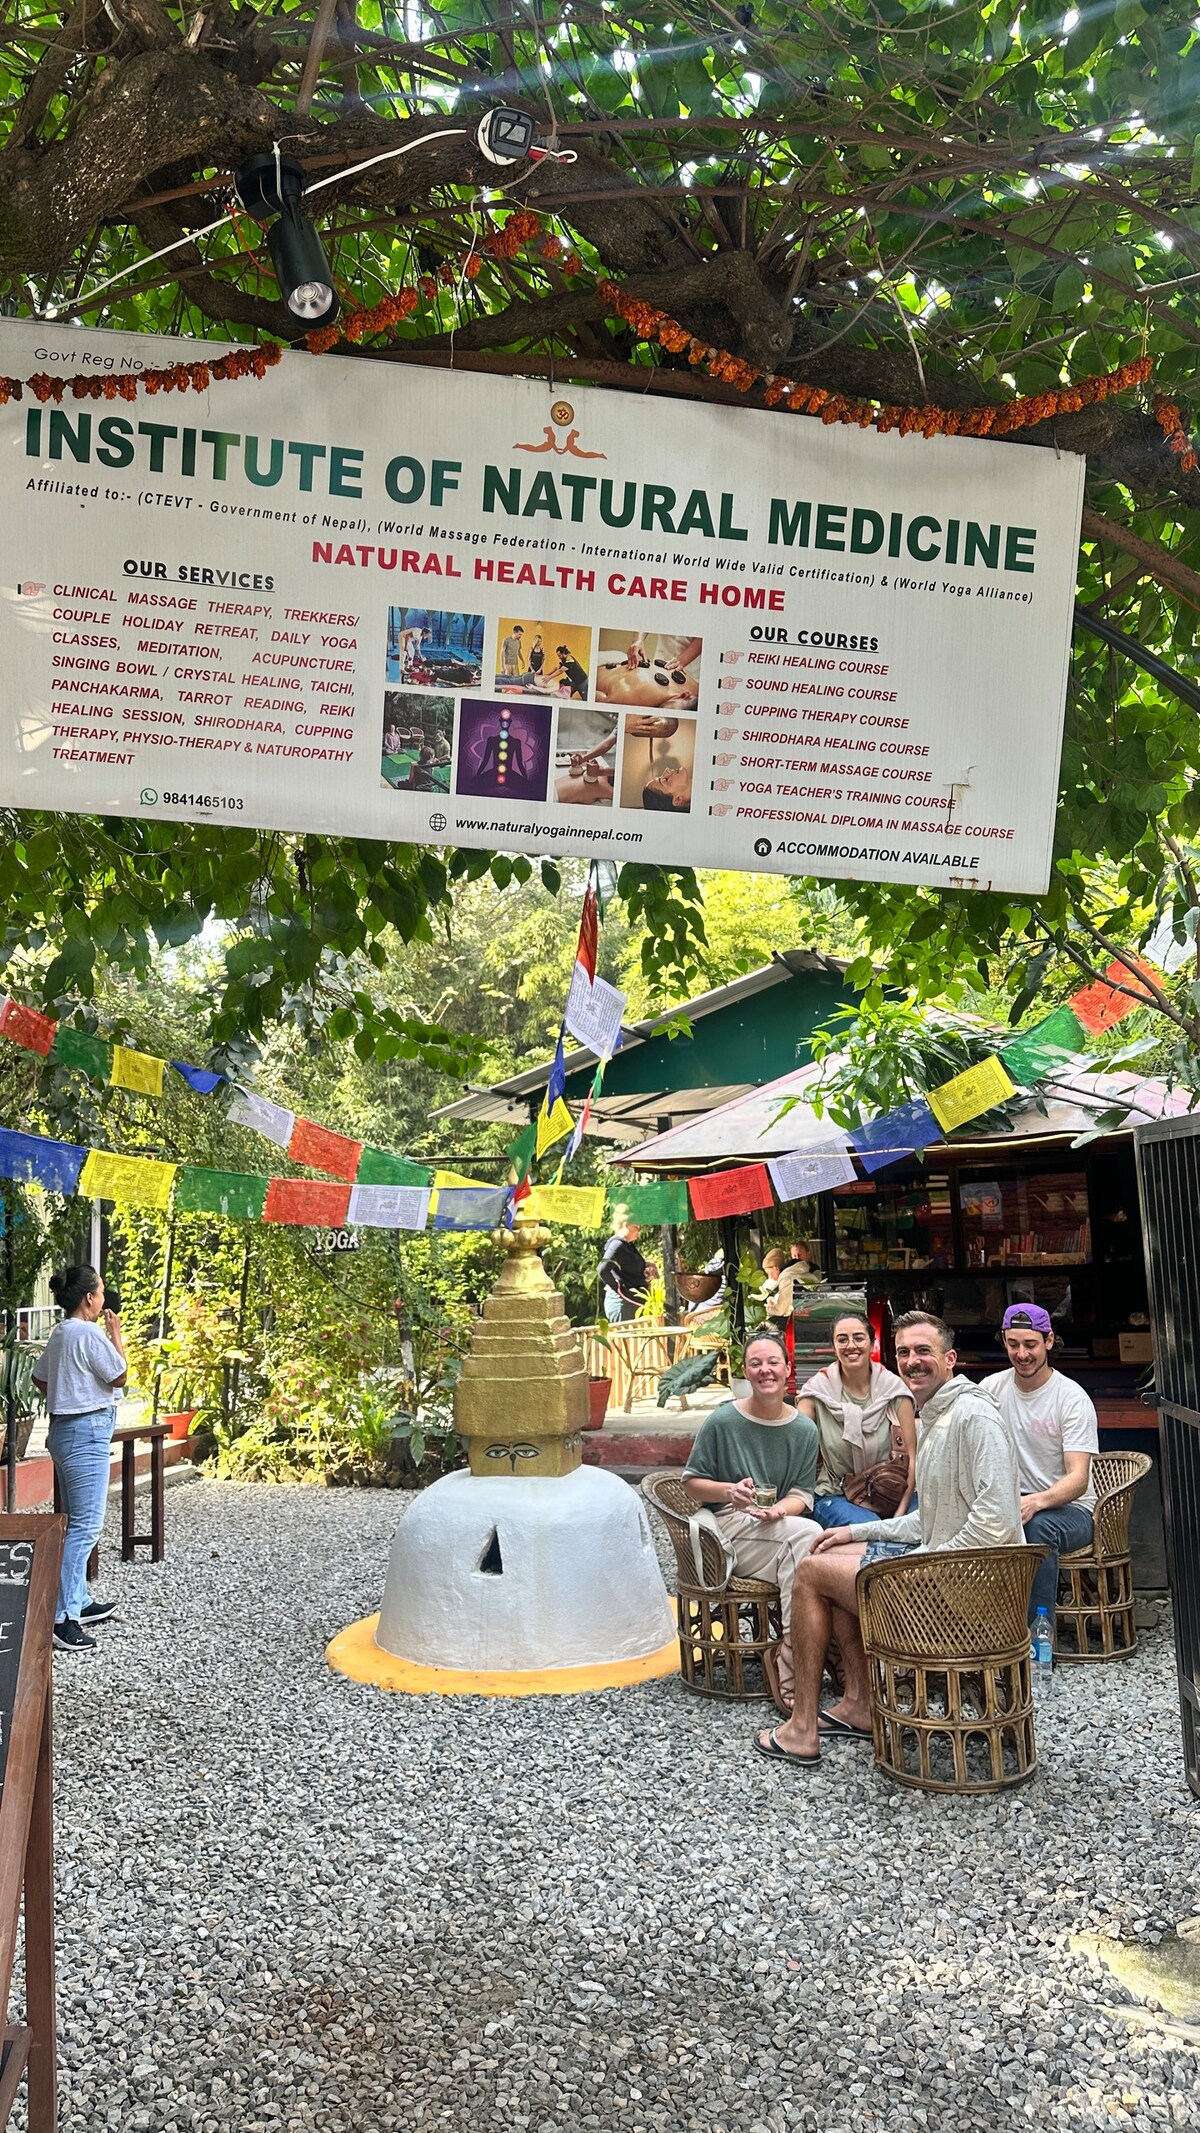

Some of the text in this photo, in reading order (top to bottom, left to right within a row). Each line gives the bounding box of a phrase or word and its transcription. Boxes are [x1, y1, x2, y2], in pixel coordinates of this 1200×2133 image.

[34, 347, 77, 363] Govt
[81, 352, 115, 370] Reg
[25, 407, 1037, 574] INSTITUTE OF NATURAL MEDICINE
[25, 478, 99, 498] Affiliated
[105, 488, 131, 501] to:-
[138, 491, 193, 509] (CTEVT
[210, 500, 297, 523] Government
[302, 513, 318, 525] of
[321, 515, 371, 533] Nepal),
[377, 520, 424, 536] (World
[428, 525, 488, 545] Massage
[492, 533, 566, 552] Federation
[581, 543, 668, 564] International
[672, 553, 711, 568] World
[715, 558, 746, 572] Wide
[752, 561, 785, 576] Valid
[789, 565, 875, 588] Certification)
[880, 575, 888, 587] &
[893, 577, 937, 592] (World
[942, 581, 972, 597] Yoga
[975, 586, 1033, 605] Alliance)
[123, 559, 274, 590] OUR SERVICES
[312, 541, 786, 612] NATURAL HEALTH CARE HOME
[53, 584, 361, 627] CLINICAL MASSAGE THERAPY, TREKKERS/
[52, 608, 357, 650] COUPLE HOLIDAY RETREAT, DAILY YOGA
[750, 625, 879, 651] OUR COURSES
[52, 631, 356, 674] CLASSES, MEDITATION, ACUPUNCTURE,
[747, 652, 890, 676] REIKI HEALING COURSE
[51, 655, 355, 697] SINGING BOWL / CRYSTAL HEALING, TAICHI,
[745, 678, 898, 703] SOUND HEALING COURSE
[51, 678, 355, 718] PANCHAKARMA, TARROT READING, REIKI
[51, 702, 354, 740] HEALING SESSION, SHIRODHARA, CUPPING
[744, 704, 910, 729] CUPPING THERAPY COURSE
[52, 725, 354, 762] THERAPY, PHYSIO-THERAPY & NATUROPATHY
[52, 747, 136, 765] TREATMENT
[741, 730, 931, 757] SHIRODHARA HEALING COURSE
[740, 756, 933, 782] SHORT-TERM MASSAGE COURSE
[162, 792, 244, 810] 9841465103
[739, 781, 957, 813] YOGA TEACHER'S TRAINING COURSE
[455, 819, 643, 842] www.naturalyogainnepal.com
[736, 807, 1015, 840] PROFESSIONAL DIPLOMA IN MASSAGE COURSE
[775, 841, 980, 869] ACCOMMODATION AVAILABLE
[315, 1230, 360, 1250] YOGA
